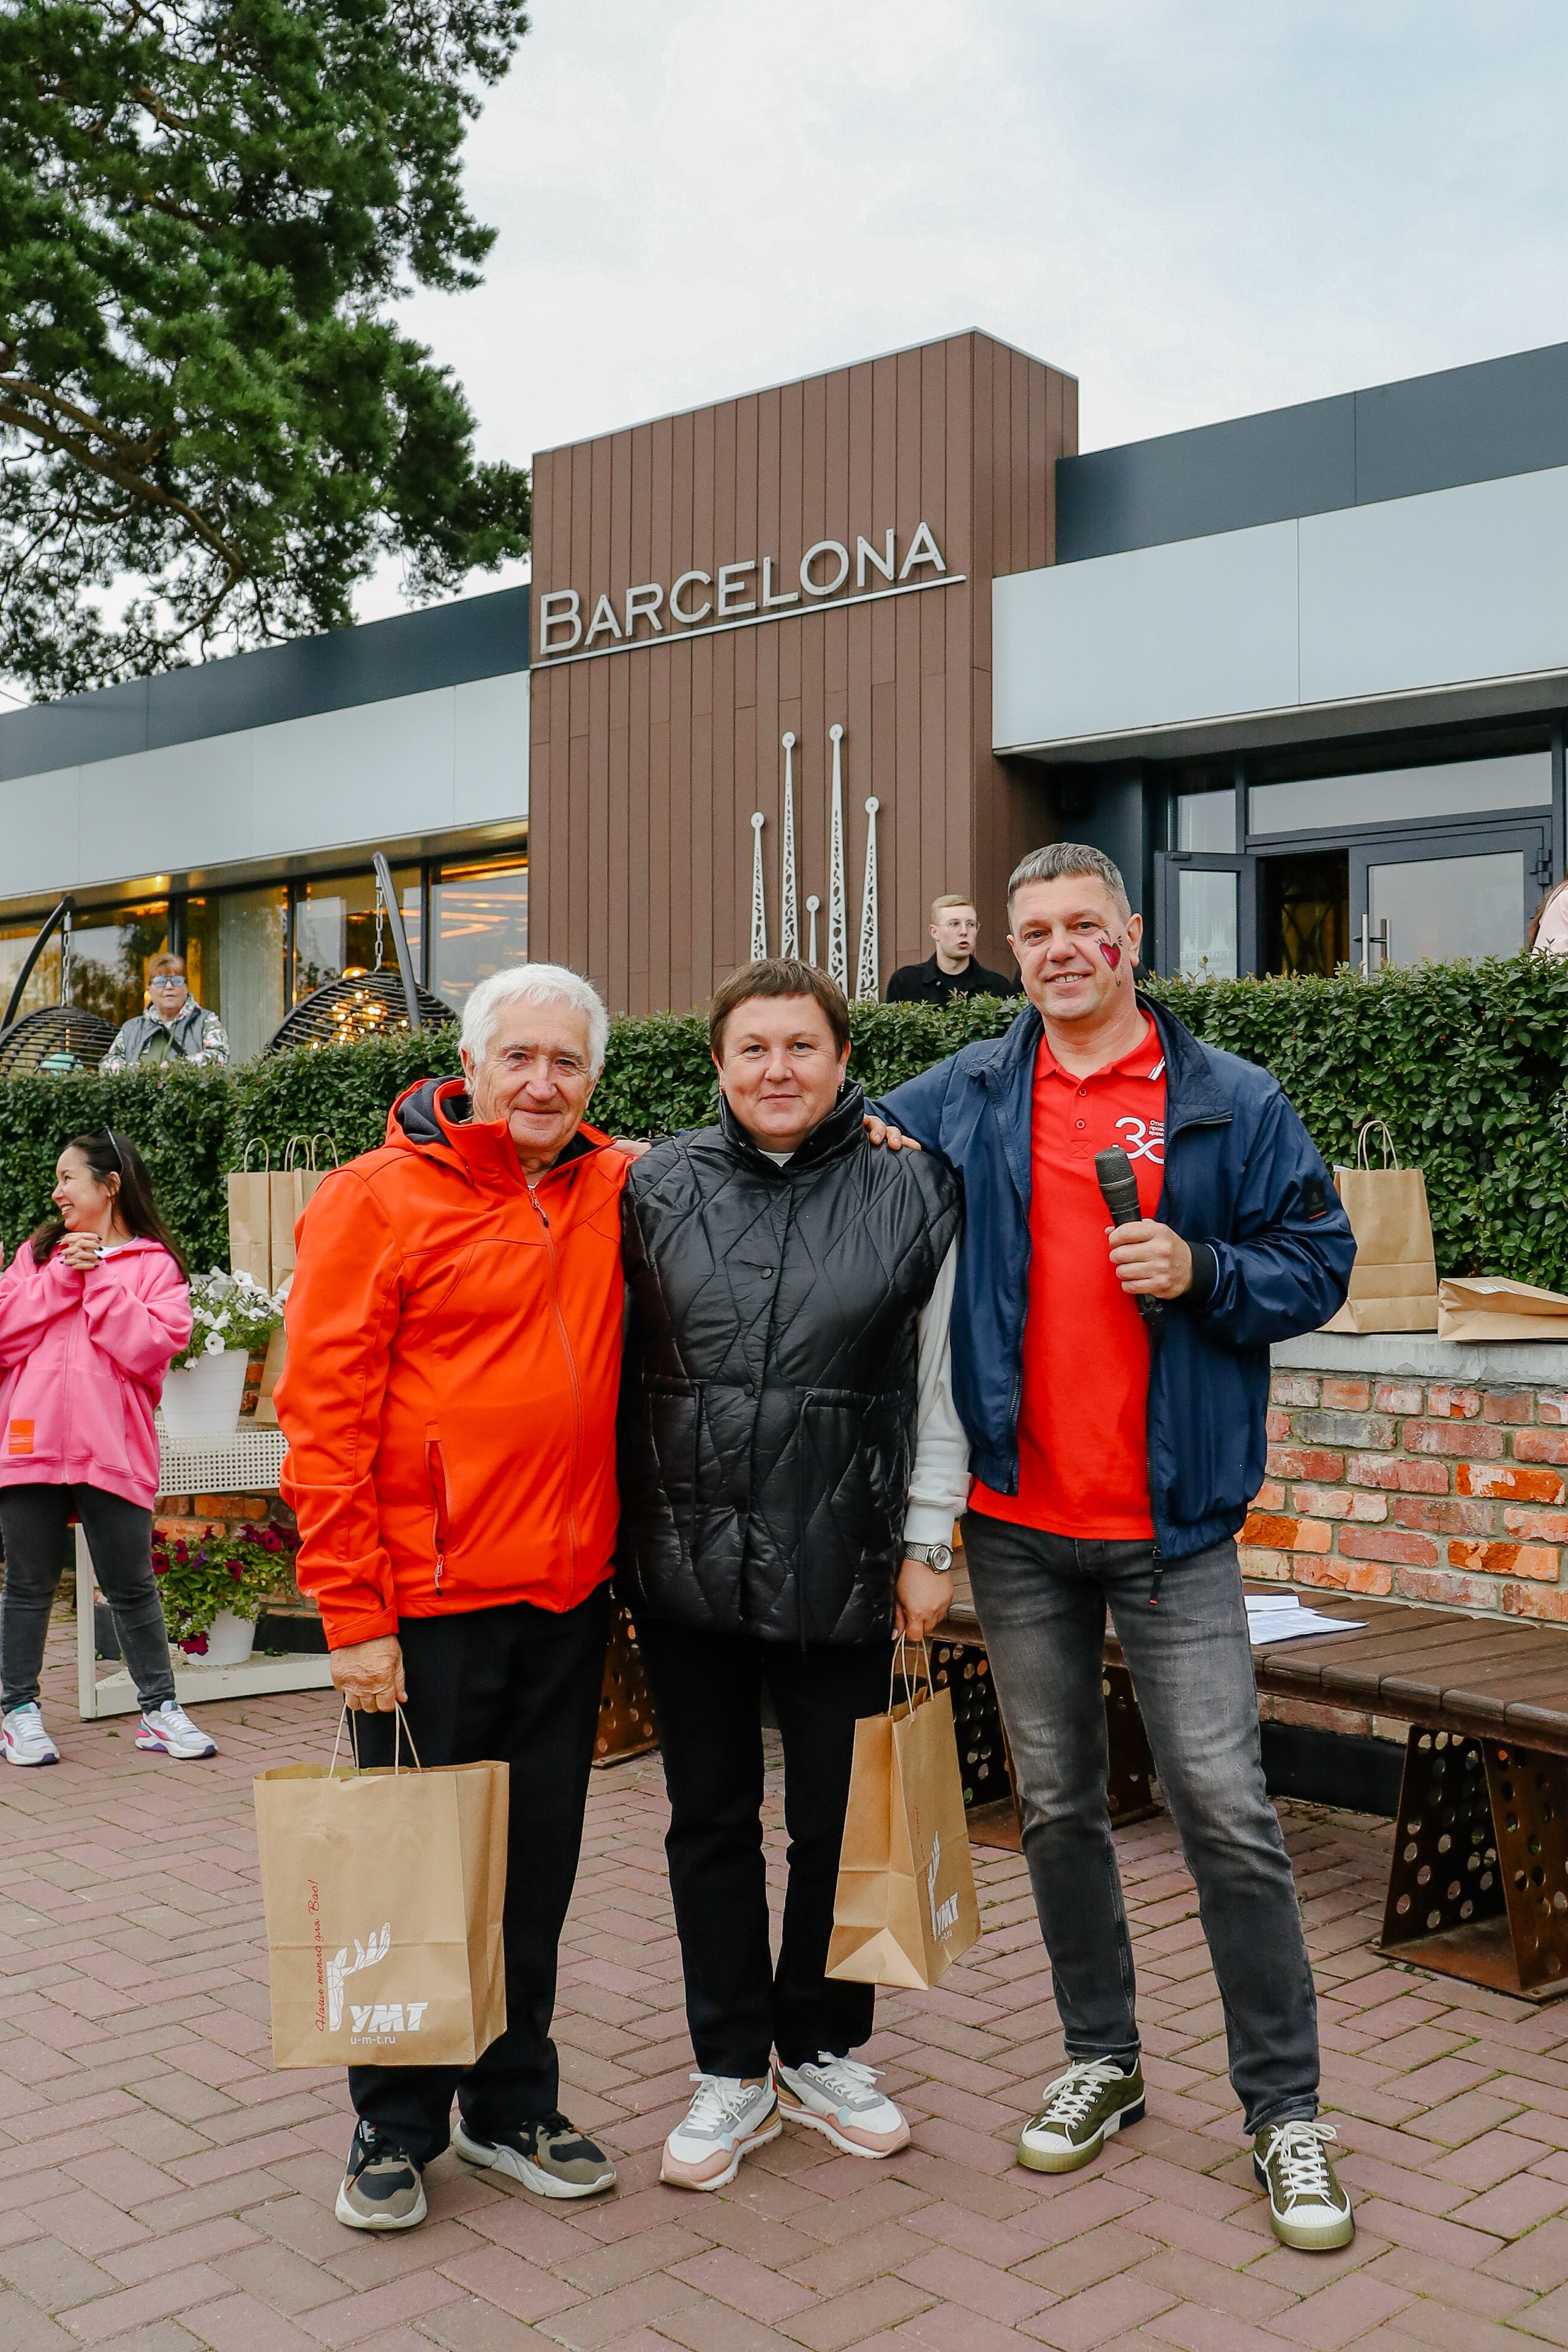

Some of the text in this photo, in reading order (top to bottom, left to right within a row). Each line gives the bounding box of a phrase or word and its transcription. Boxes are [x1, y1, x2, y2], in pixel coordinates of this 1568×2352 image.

[540, 521, 947, 655] BARCELONA
[314, 1918, 325, 1942] для
[314, 1945, 324, 1985] тепло
[315, 1988, 326, 2032] Наше
[349, 2001, 429, 2033] УМТ
[350, 2035, 396, 2045] u-m-t.ru
